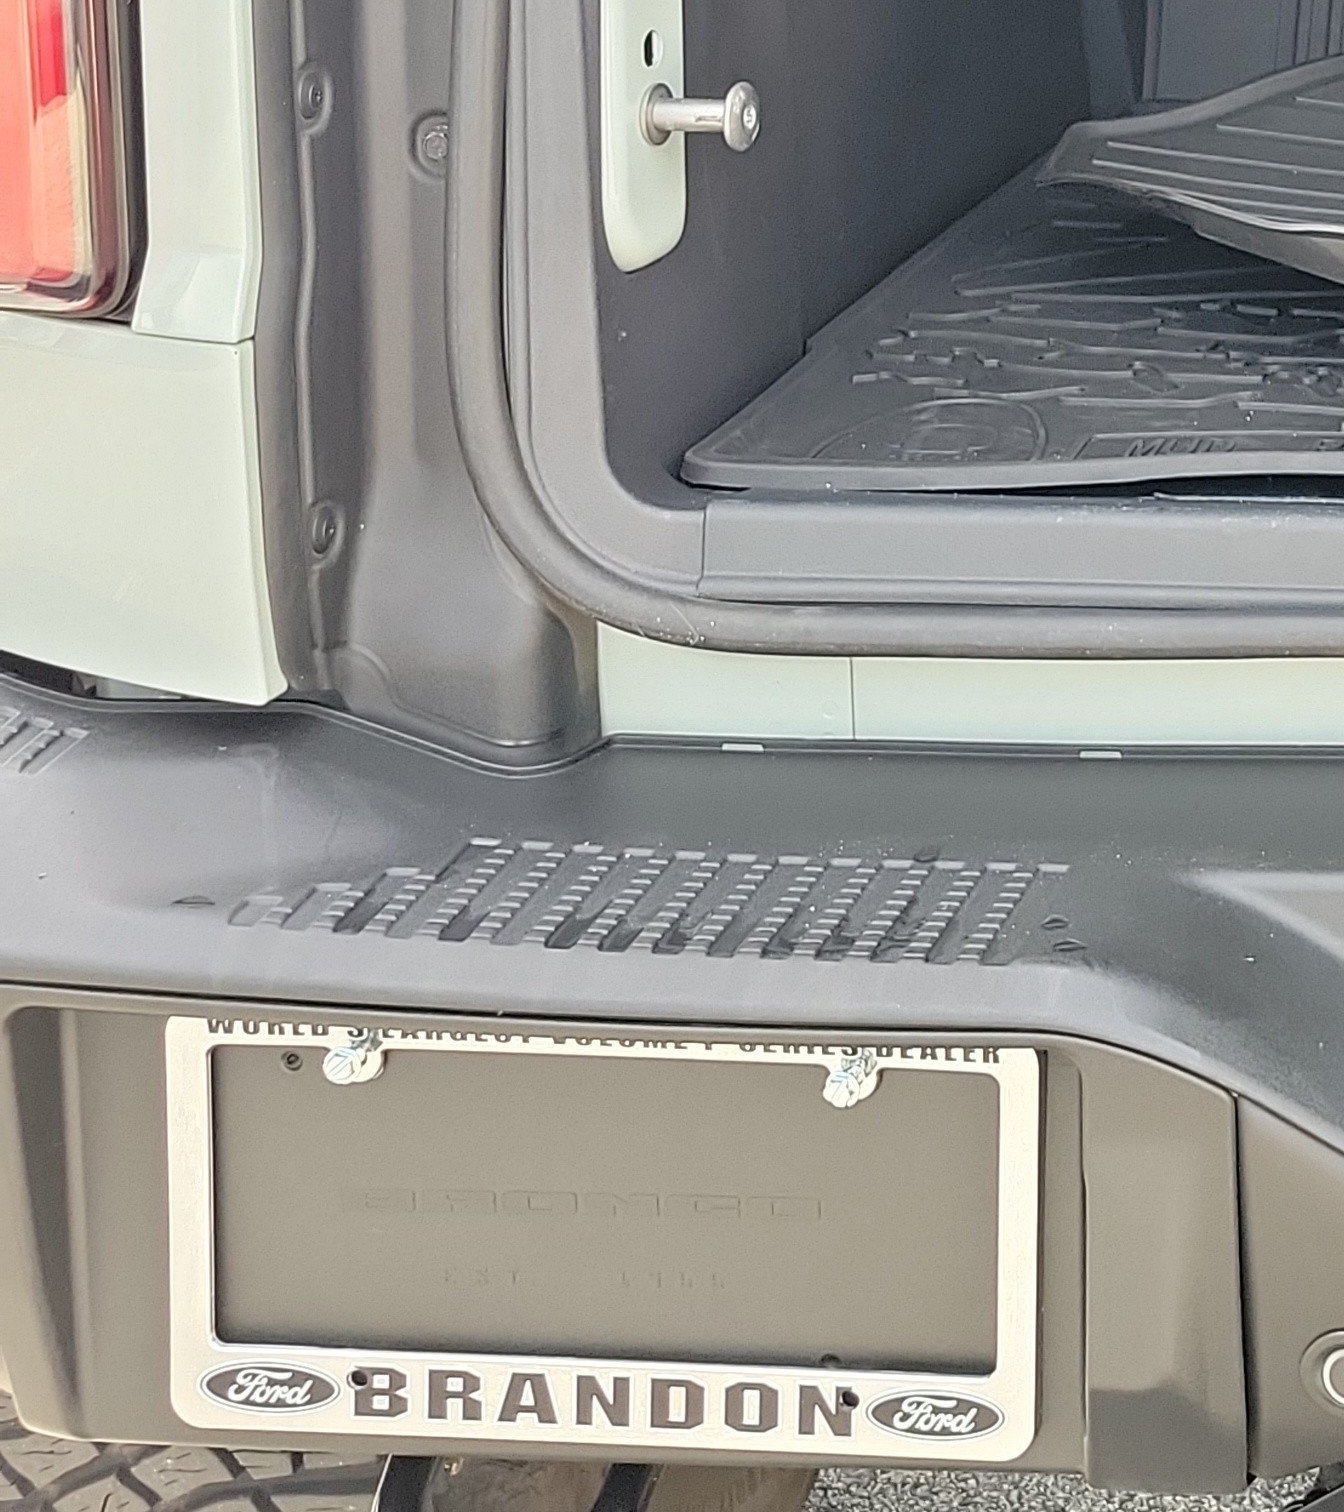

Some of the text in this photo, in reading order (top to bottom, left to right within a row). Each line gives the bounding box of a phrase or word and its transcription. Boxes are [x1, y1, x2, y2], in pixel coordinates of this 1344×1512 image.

[338, 1190, 822, 1220] BRONCO
[228, 1368, 311, 1406] Ford
[351, 1365, 855, 1438] BRANDON
[893, 1394, 978, 1434] Ford
